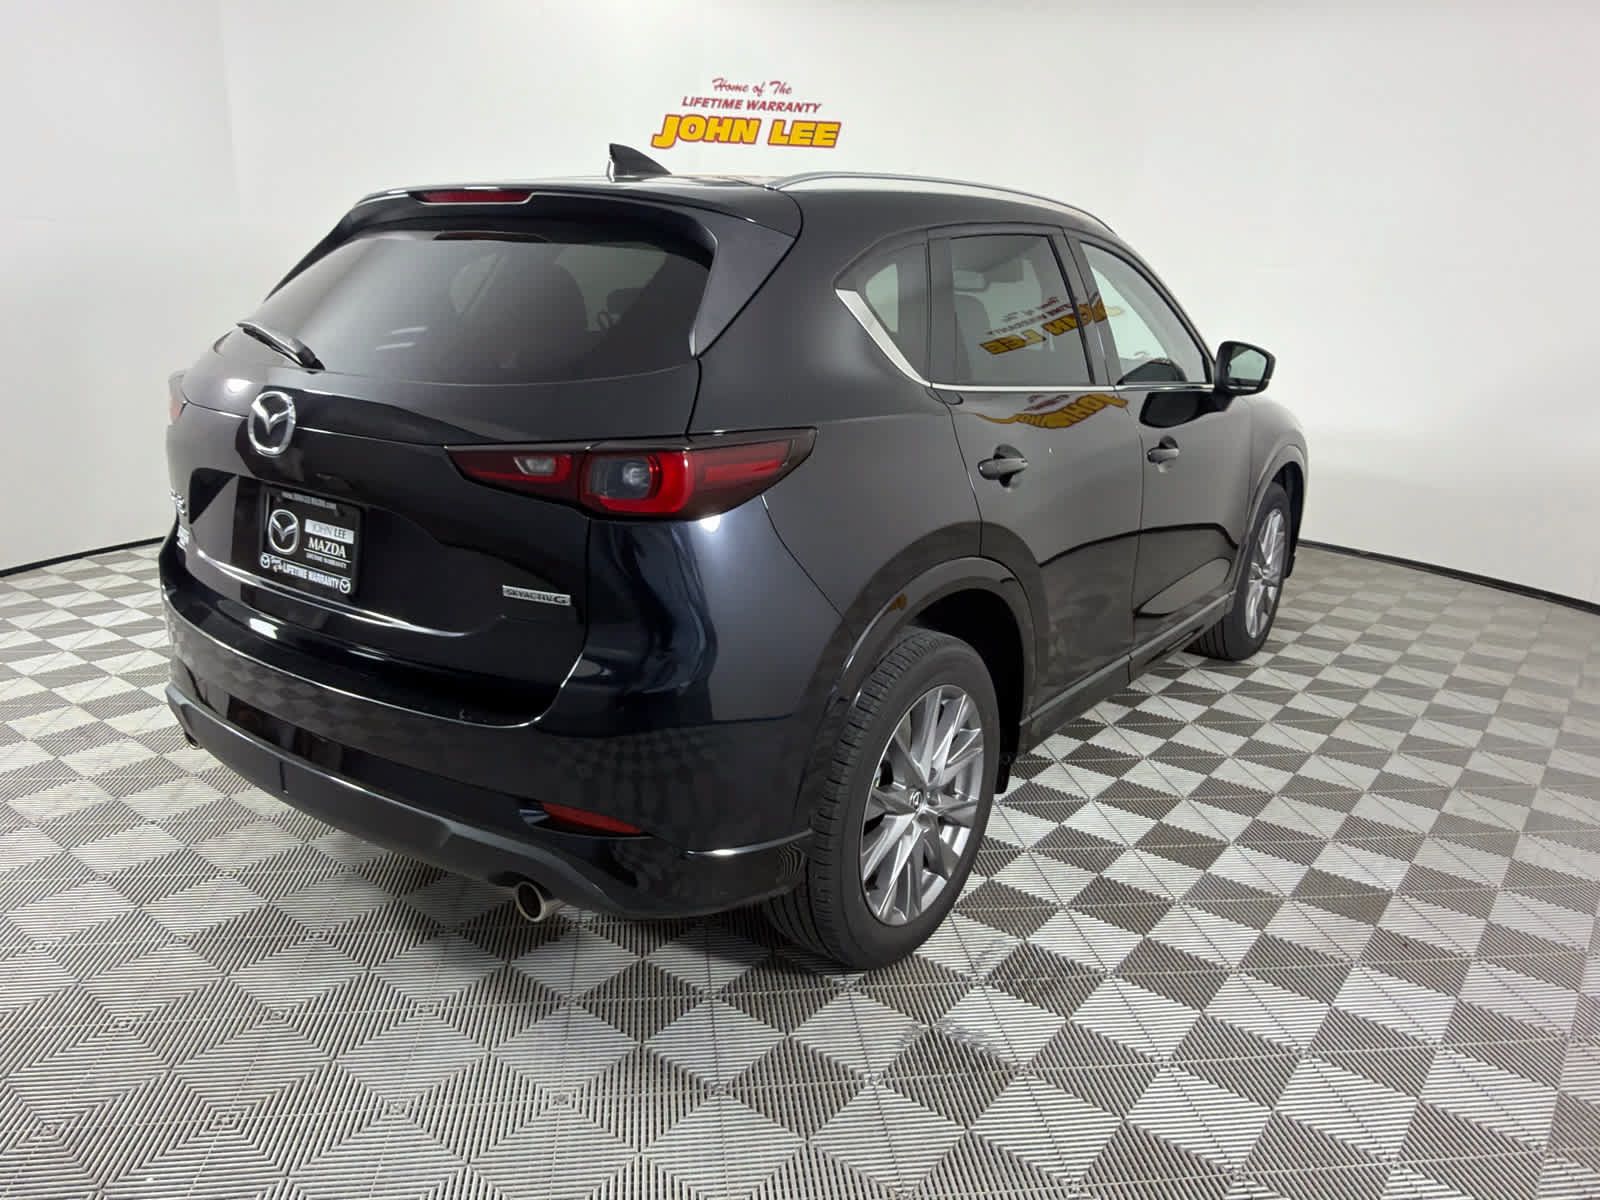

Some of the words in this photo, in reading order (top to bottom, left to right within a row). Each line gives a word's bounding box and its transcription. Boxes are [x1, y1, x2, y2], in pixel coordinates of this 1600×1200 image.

[712, 77, 749, 93] Home
[752, 82, 767, 97] of
[769, 80, 793, 95] The
[682, 96, 744, 110] LIFETIME
[746, 100, 822, 113] WARRANTY
[651, 114, 762, 149] JOHN
[768, 119, 842, 148] LEE
[334, 528, 348, 540] LEE
[308, 536, 347, 559] MAZDA
[283, 561, 308, 579] LIFETIME
[308, 569, 340, 589] WARRANTY
